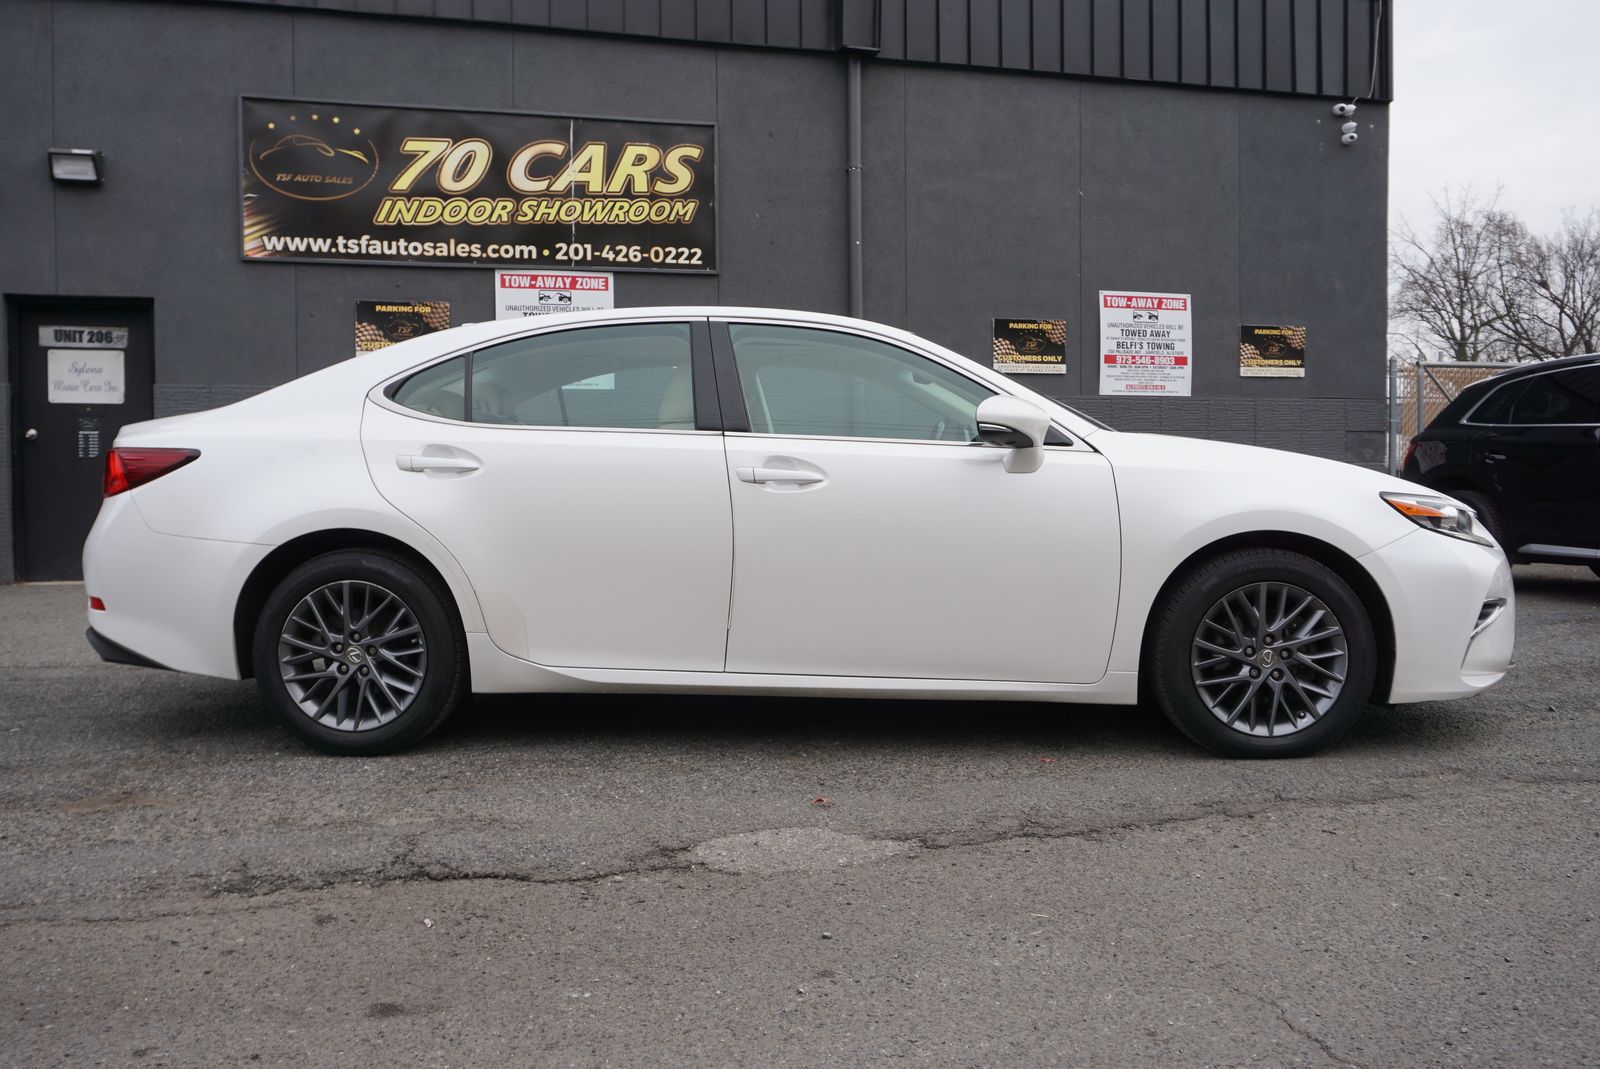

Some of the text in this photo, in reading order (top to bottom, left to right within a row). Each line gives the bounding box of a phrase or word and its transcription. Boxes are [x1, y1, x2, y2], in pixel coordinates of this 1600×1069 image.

[388, 137, 704, 196] 70 CARS
[276, 173, 354, 185] TSF AUTO SALES
[373, 197, 699, 225] INDOOR SHOWROOM
[262, 234, 703, 265] www.tsfautosales.com 201-426-0222
[503, 275, 606, 290] TOW-AWAY ZONE
[375, 305, 432, 313] PARKING FOR
[505, 304, 551, 312] UNAUTHORIZED
[1105, 296, 1185, 310] TOW-AWAY ZONE
[53, 329, 113, 344] UNIT 206
[1120, 329, 1171, 338] TOWED AWAY
[1147, 342, 1175, 350] TOWING
